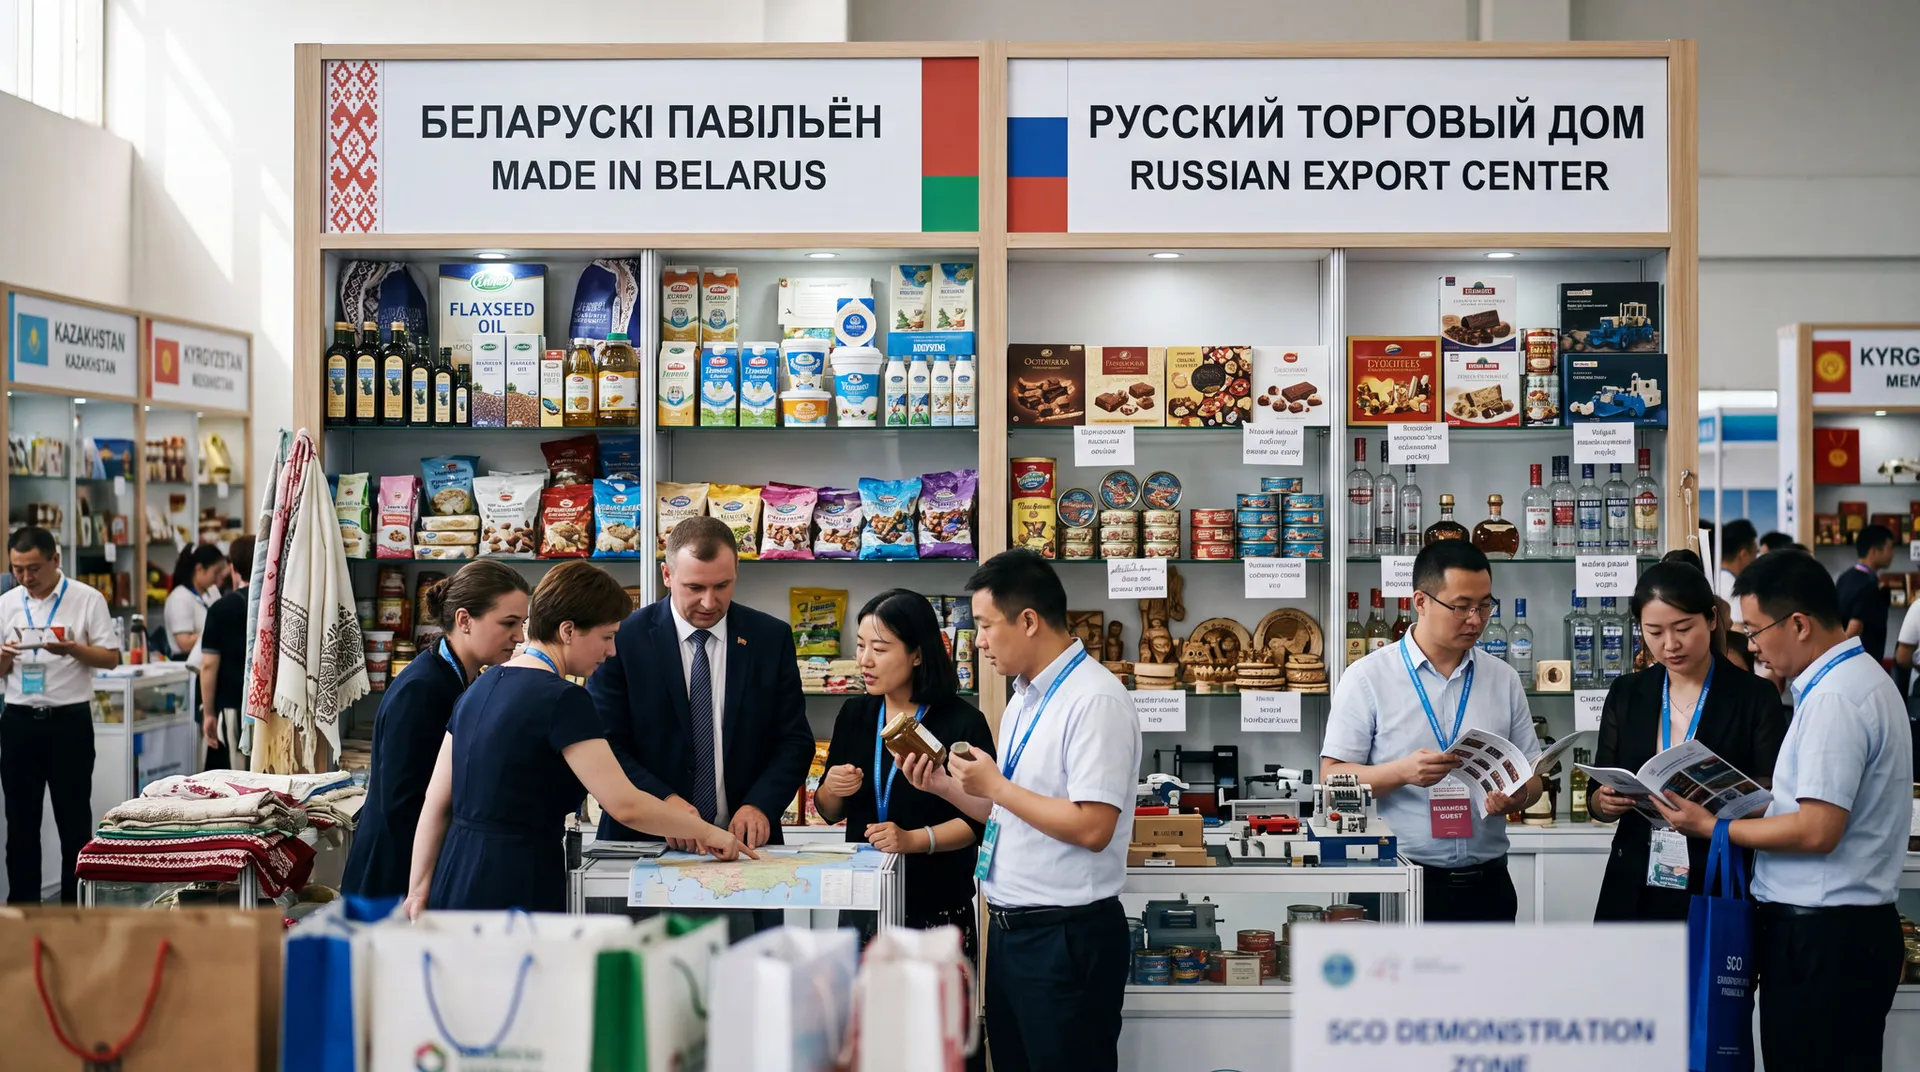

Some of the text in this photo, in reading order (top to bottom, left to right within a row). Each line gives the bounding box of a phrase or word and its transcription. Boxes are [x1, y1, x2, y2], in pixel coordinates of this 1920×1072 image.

[422, 96, 881, 139] БЕЛАРУСКІ ПАВІЛЬЁН
[1090, 96, 1644, 145] РУССКИЙ ТОРГОВЫЙ ДОМ
[492, 159, 827, 191] MADE IN BELARUS
[1131, 159, 1610, 191] RUSSIAN EXPORT CENTER
[449, 302, 535, 317] FLAXSEED
[54, 321, 126, 353] KAZAKHSTAN
[478, 319, 506, 334] OIL
[65, 352, 117, 375] KAZAKHSTAN
[1440, 812, 1463, 820] GUEST
[1726, 955, 1743, 971] SCO
[1327, 1018, 1656, 1044] SCO DEMONSTRATION
[1451, 1055, 1530, 1072] ZONE
